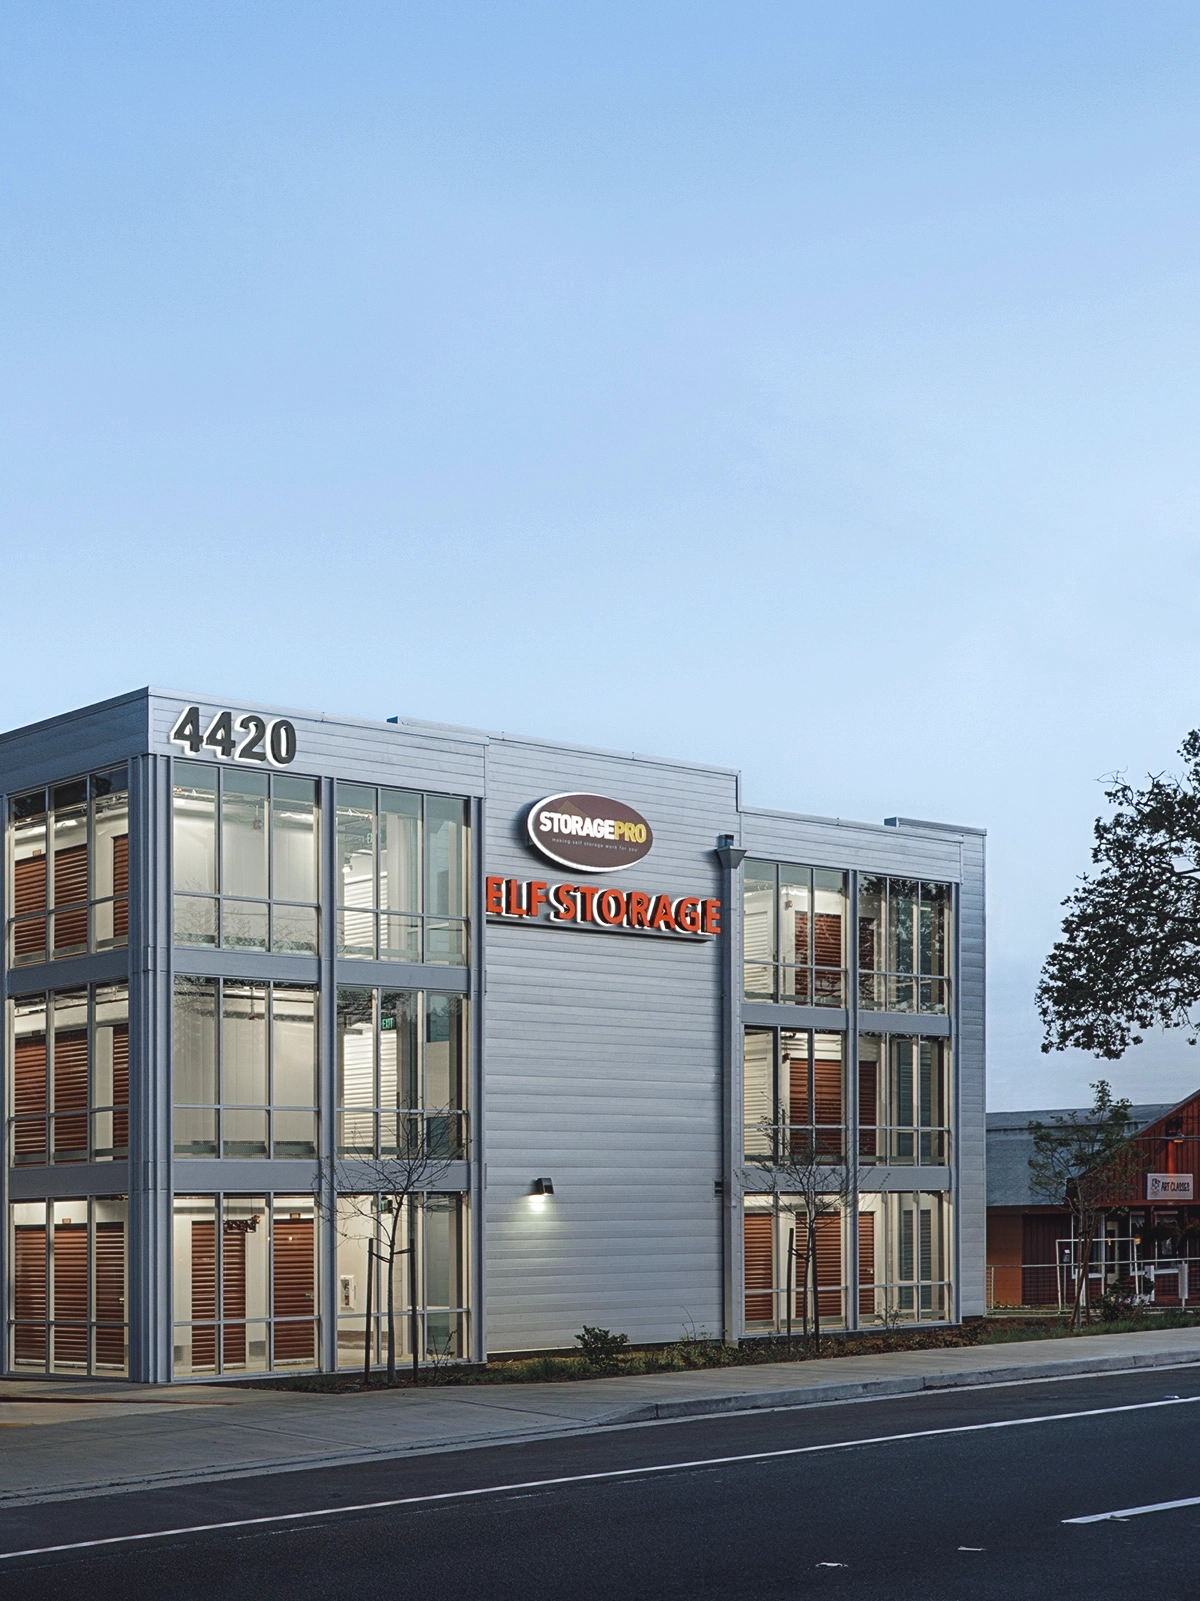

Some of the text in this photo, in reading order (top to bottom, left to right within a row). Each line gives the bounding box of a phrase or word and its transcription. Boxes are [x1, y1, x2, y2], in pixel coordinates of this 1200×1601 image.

[170, 706, 297, 766] 4420
[539, 811, 647, 843] STORAGEPRO
[584, 841, 604, 849] storage
[554, 883, 721, 934] STORAGE
